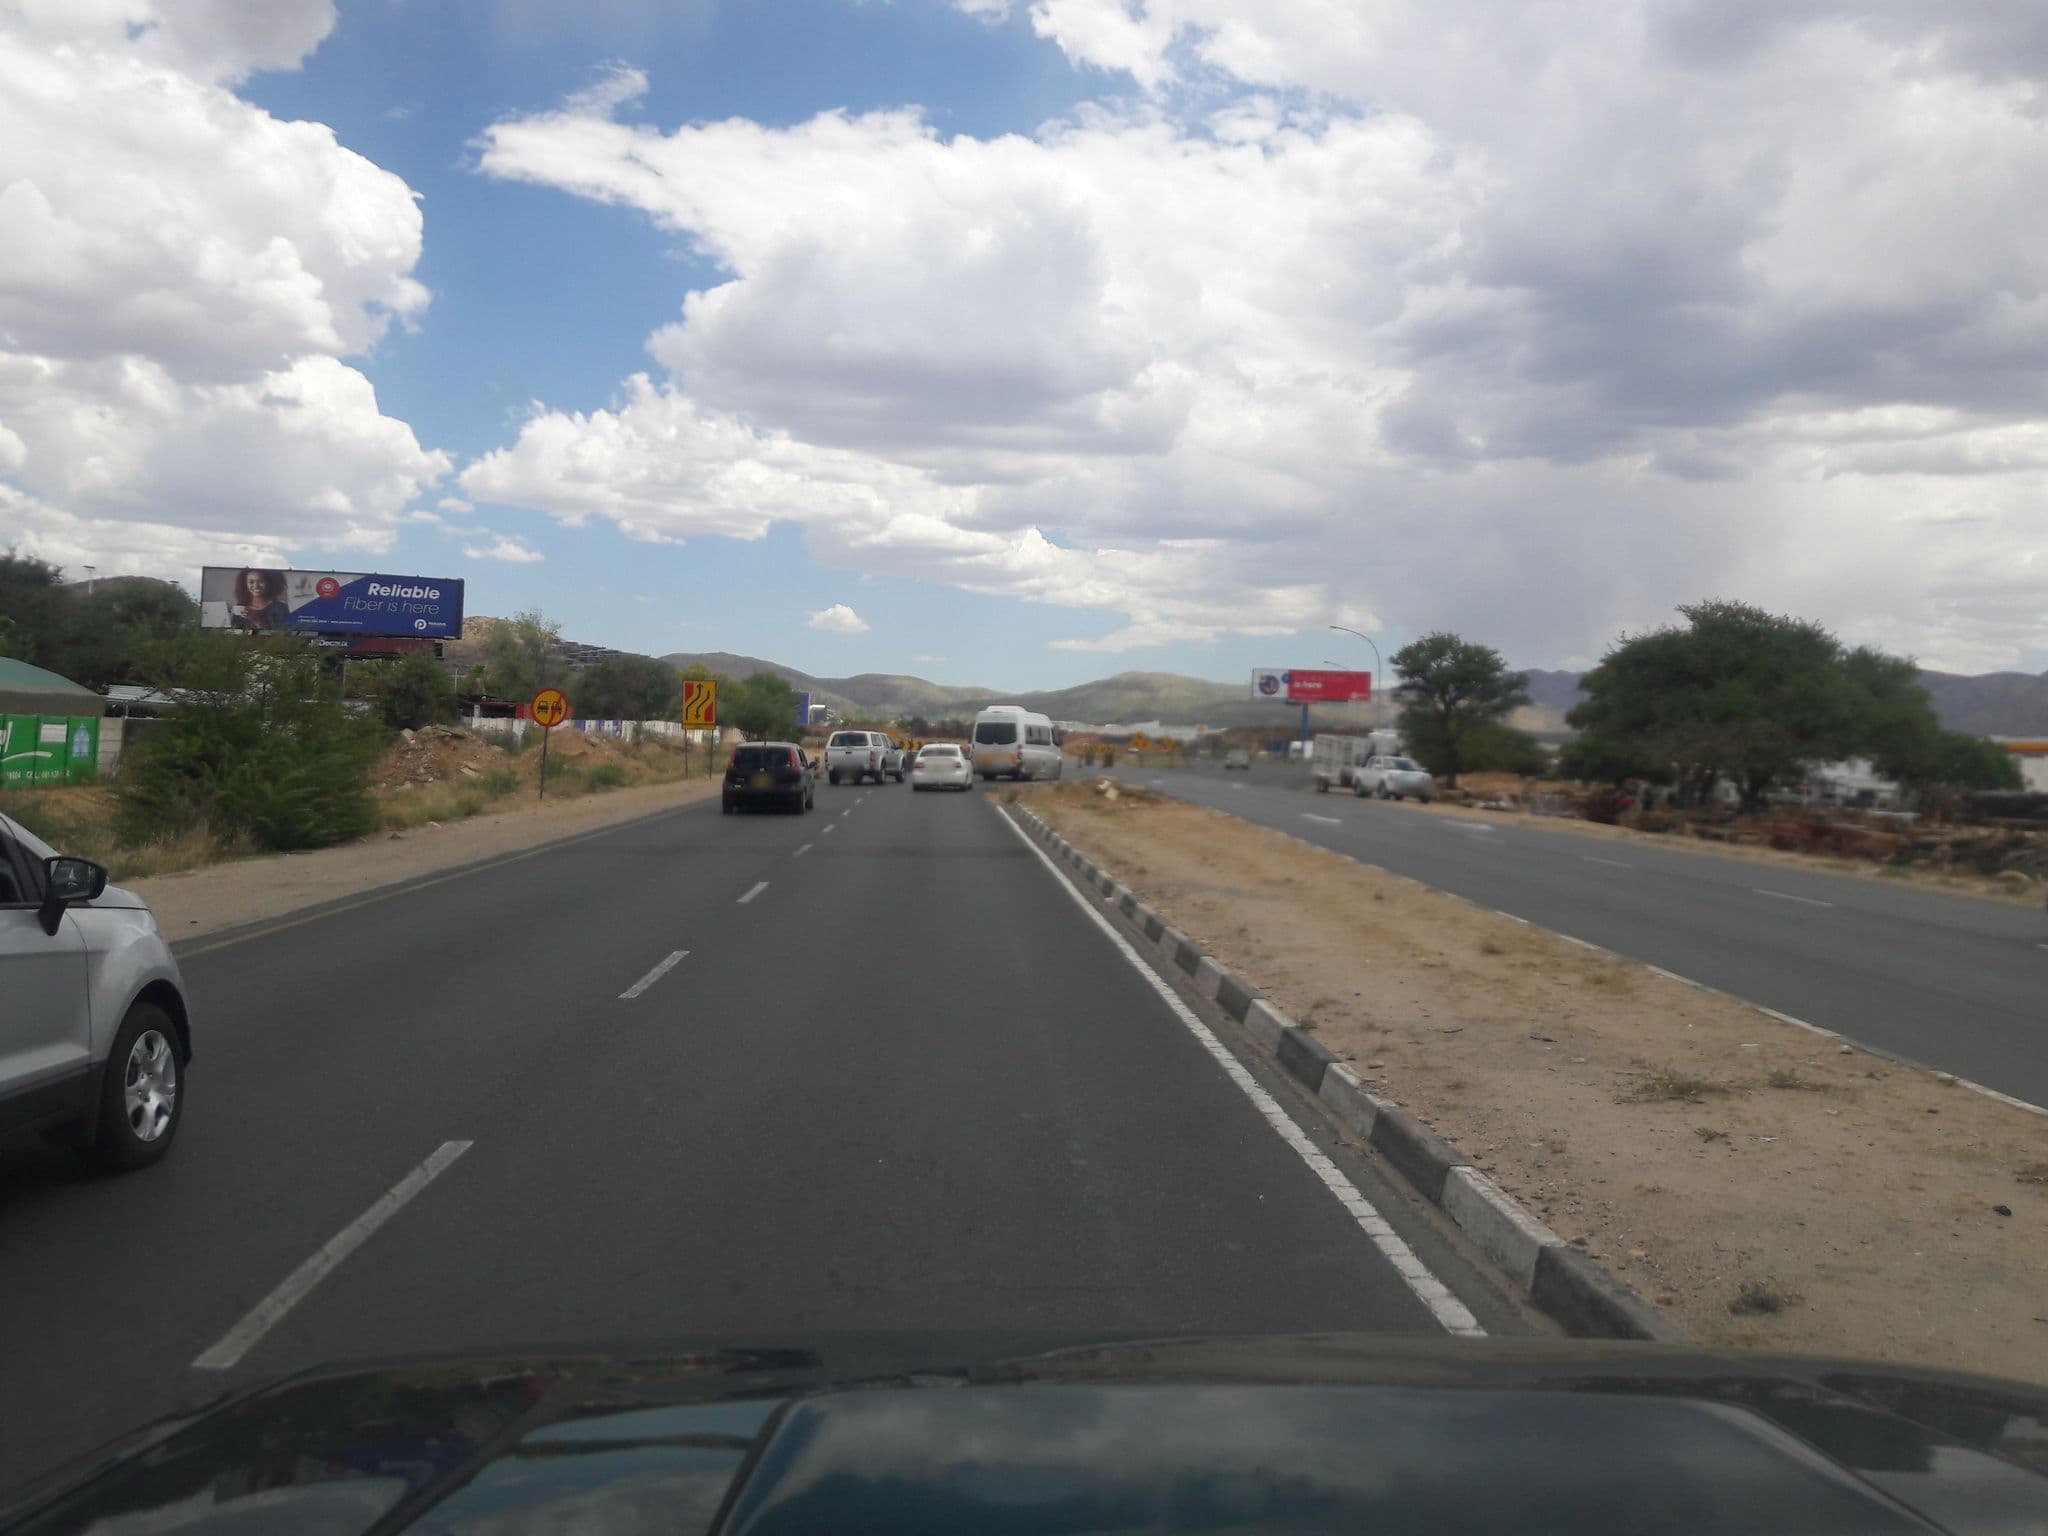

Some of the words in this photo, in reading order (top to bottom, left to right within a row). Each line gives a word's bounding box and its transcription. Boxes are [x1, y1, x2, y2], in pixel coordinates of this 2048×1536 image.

[368, 582, 441, 600] Reliable
[344, 596, 384, 611] Fiber
[388, 599, 399, 612] is
[403, 600, 440, 615] here
